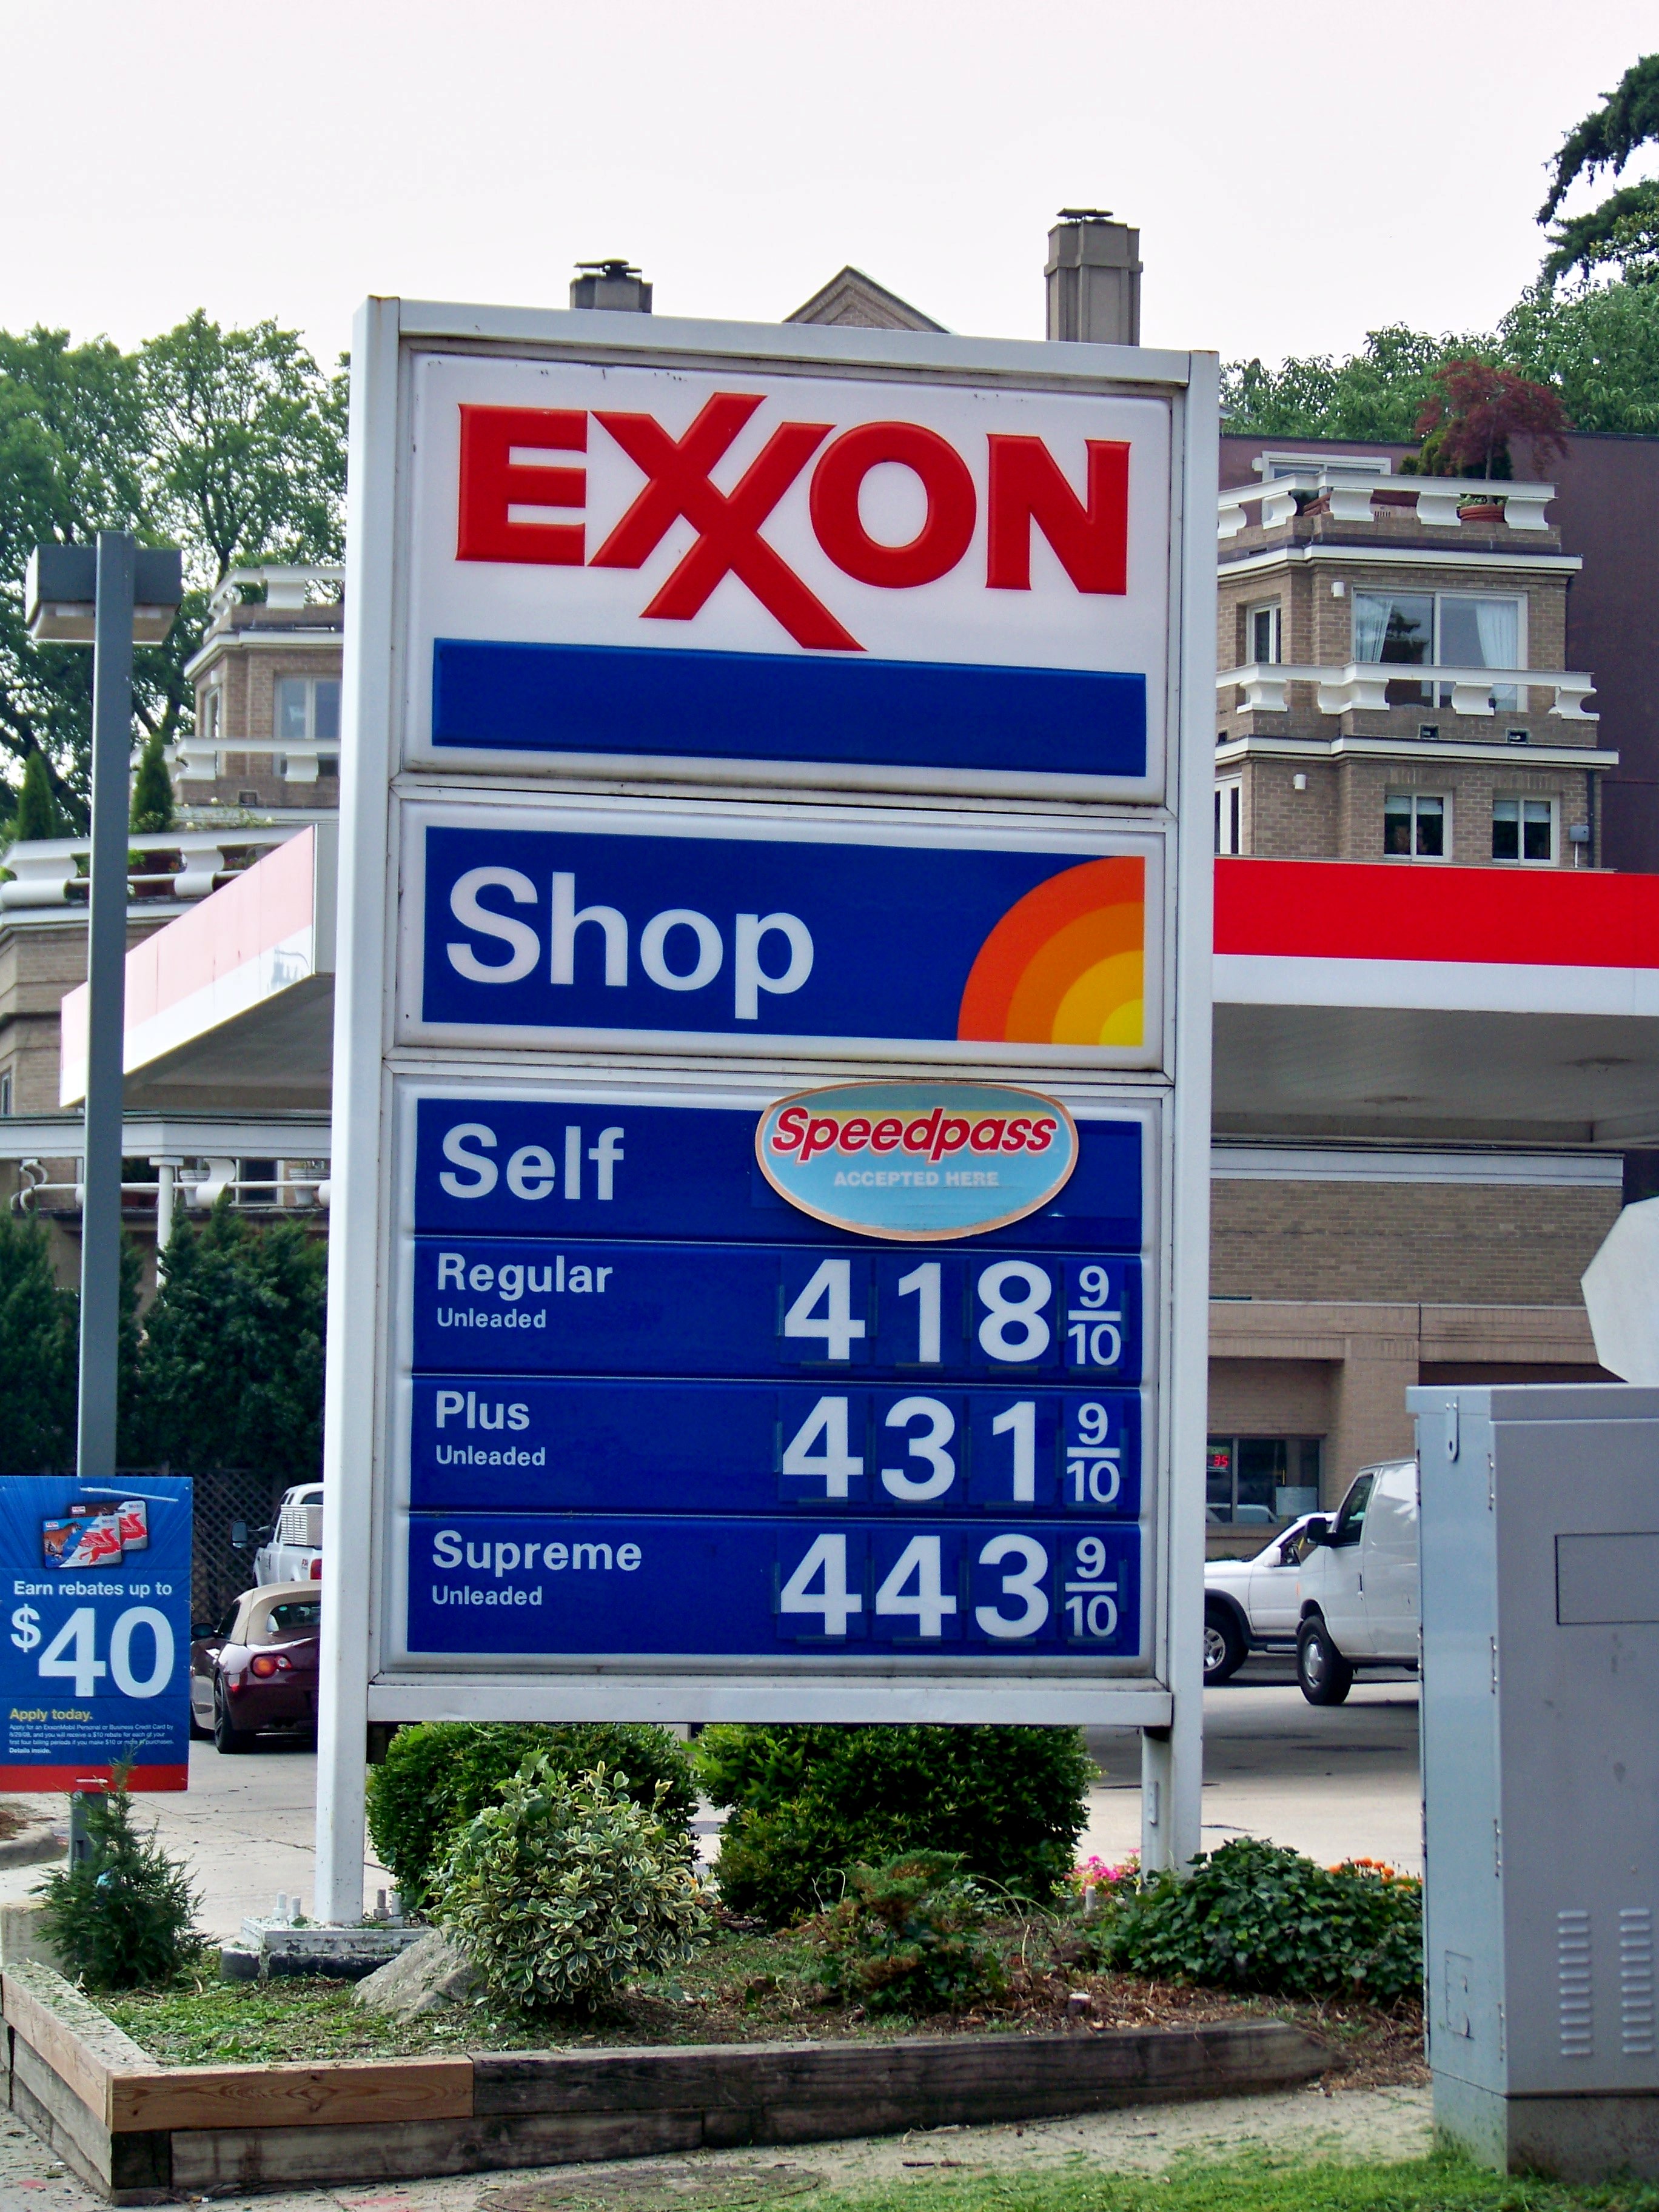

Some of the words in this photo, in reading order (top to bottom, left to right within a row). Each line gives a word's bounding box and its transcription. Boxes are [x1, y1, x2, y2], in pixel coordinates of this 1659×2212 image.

[455, 391, 1131, 652] EXXON
[447, 866, 814, 1020] Shop
[770, 1106, 1057, 1163] Speedpass
[440, 1123, 624, 1200] Self
[834, 1171, 939, 1187] ACCEPTED
[946, 1171, 999, 1187] HERE
[438, 1253, 613, 1301] Regular
[437, 1308, 546, 1328] Unleaded
[785, 1259, 1051, 1362] 418
[436, 1390, 530, 1430] Plus
[436, 1445, 545, 1466] Unleaded
[783, 1396, 1035, 1501] 431
[432, 1530, 642, 1577] Supreme
[14, 1580, 53, 1595] Earn
[59, 1581, 124, 1595] rebates
[129, 1583, 150, 1598] up
[156, 1581, 172, 1595] to
[432, 1585, 542, 1605] Unleaded
[780, 1533, 1048, 1638] 443
[11, 1603, 175, 1698] $40
[10, 1708, 47, 1721] Apply
[52, 1708, 93, 1721] today.
